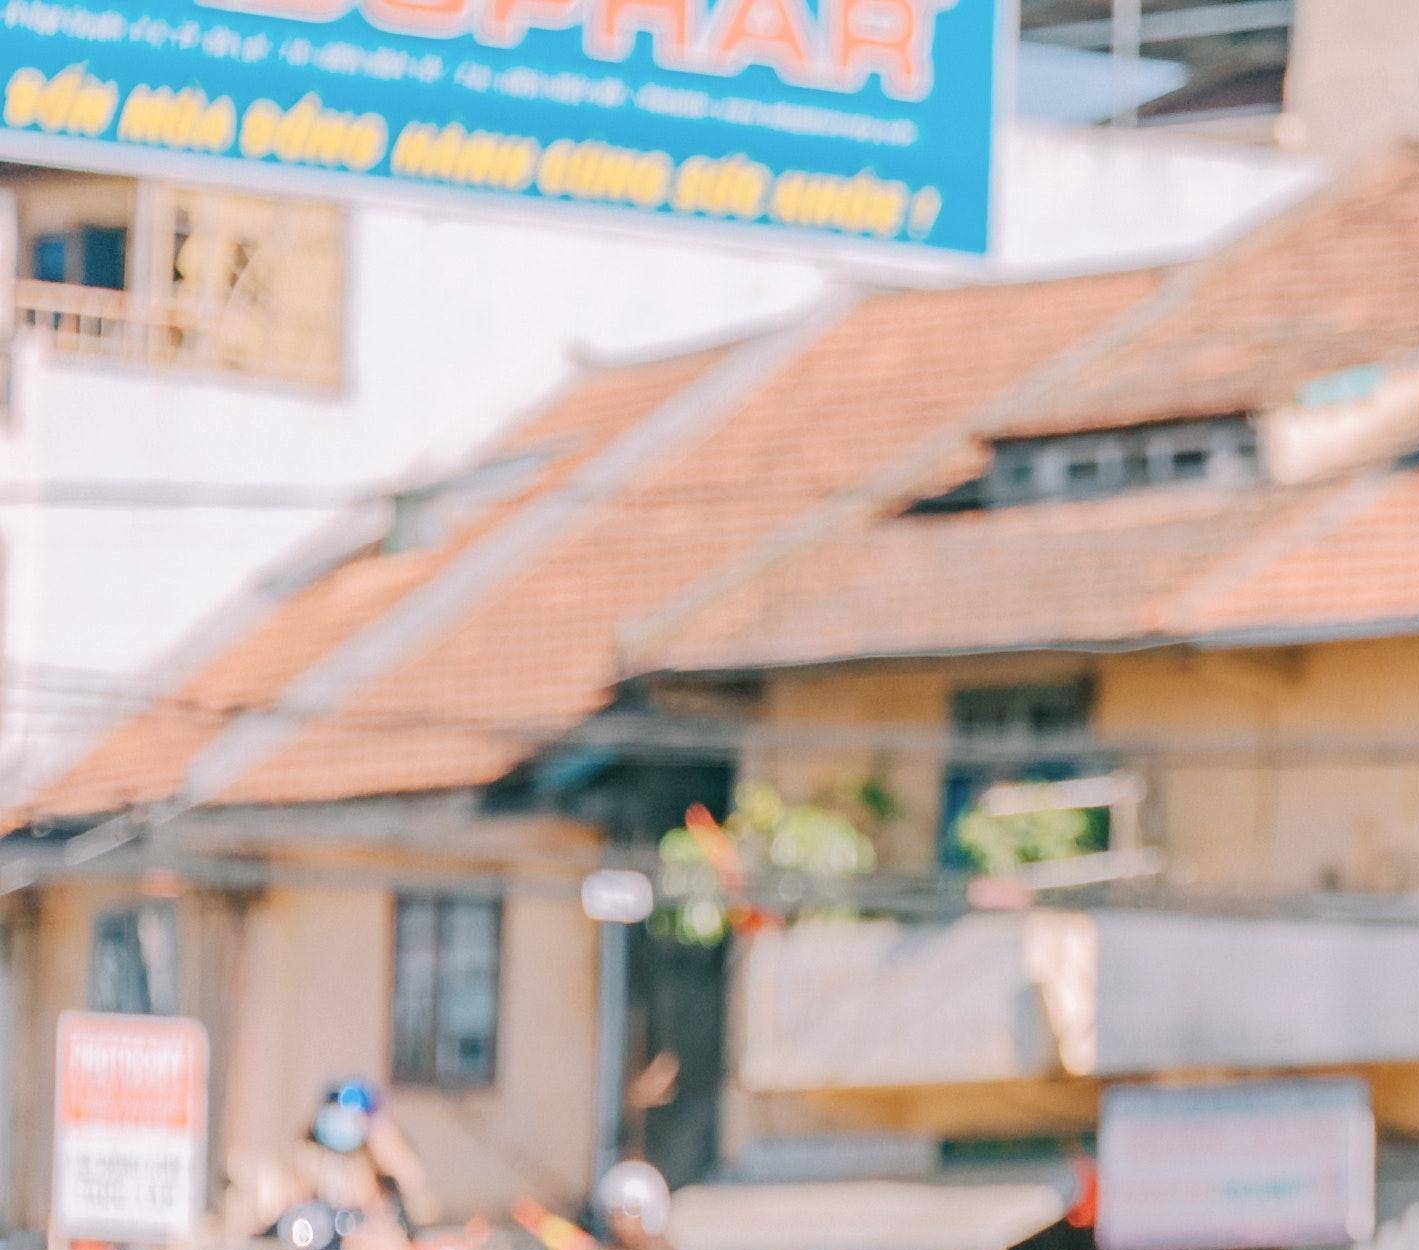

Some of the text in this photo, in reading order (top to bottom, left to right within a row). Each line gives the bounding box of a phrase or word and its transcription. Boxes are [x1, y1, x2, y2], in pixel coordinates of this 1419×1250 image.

[117, 82, 236, 151] MÙA
[239, 91, 388, 170] ĐỒNG
[390, 121, 538, 190] HÀNH
[537, 138, 672, 206] CÙNG
[673, 152, 770, 219] SỨC
